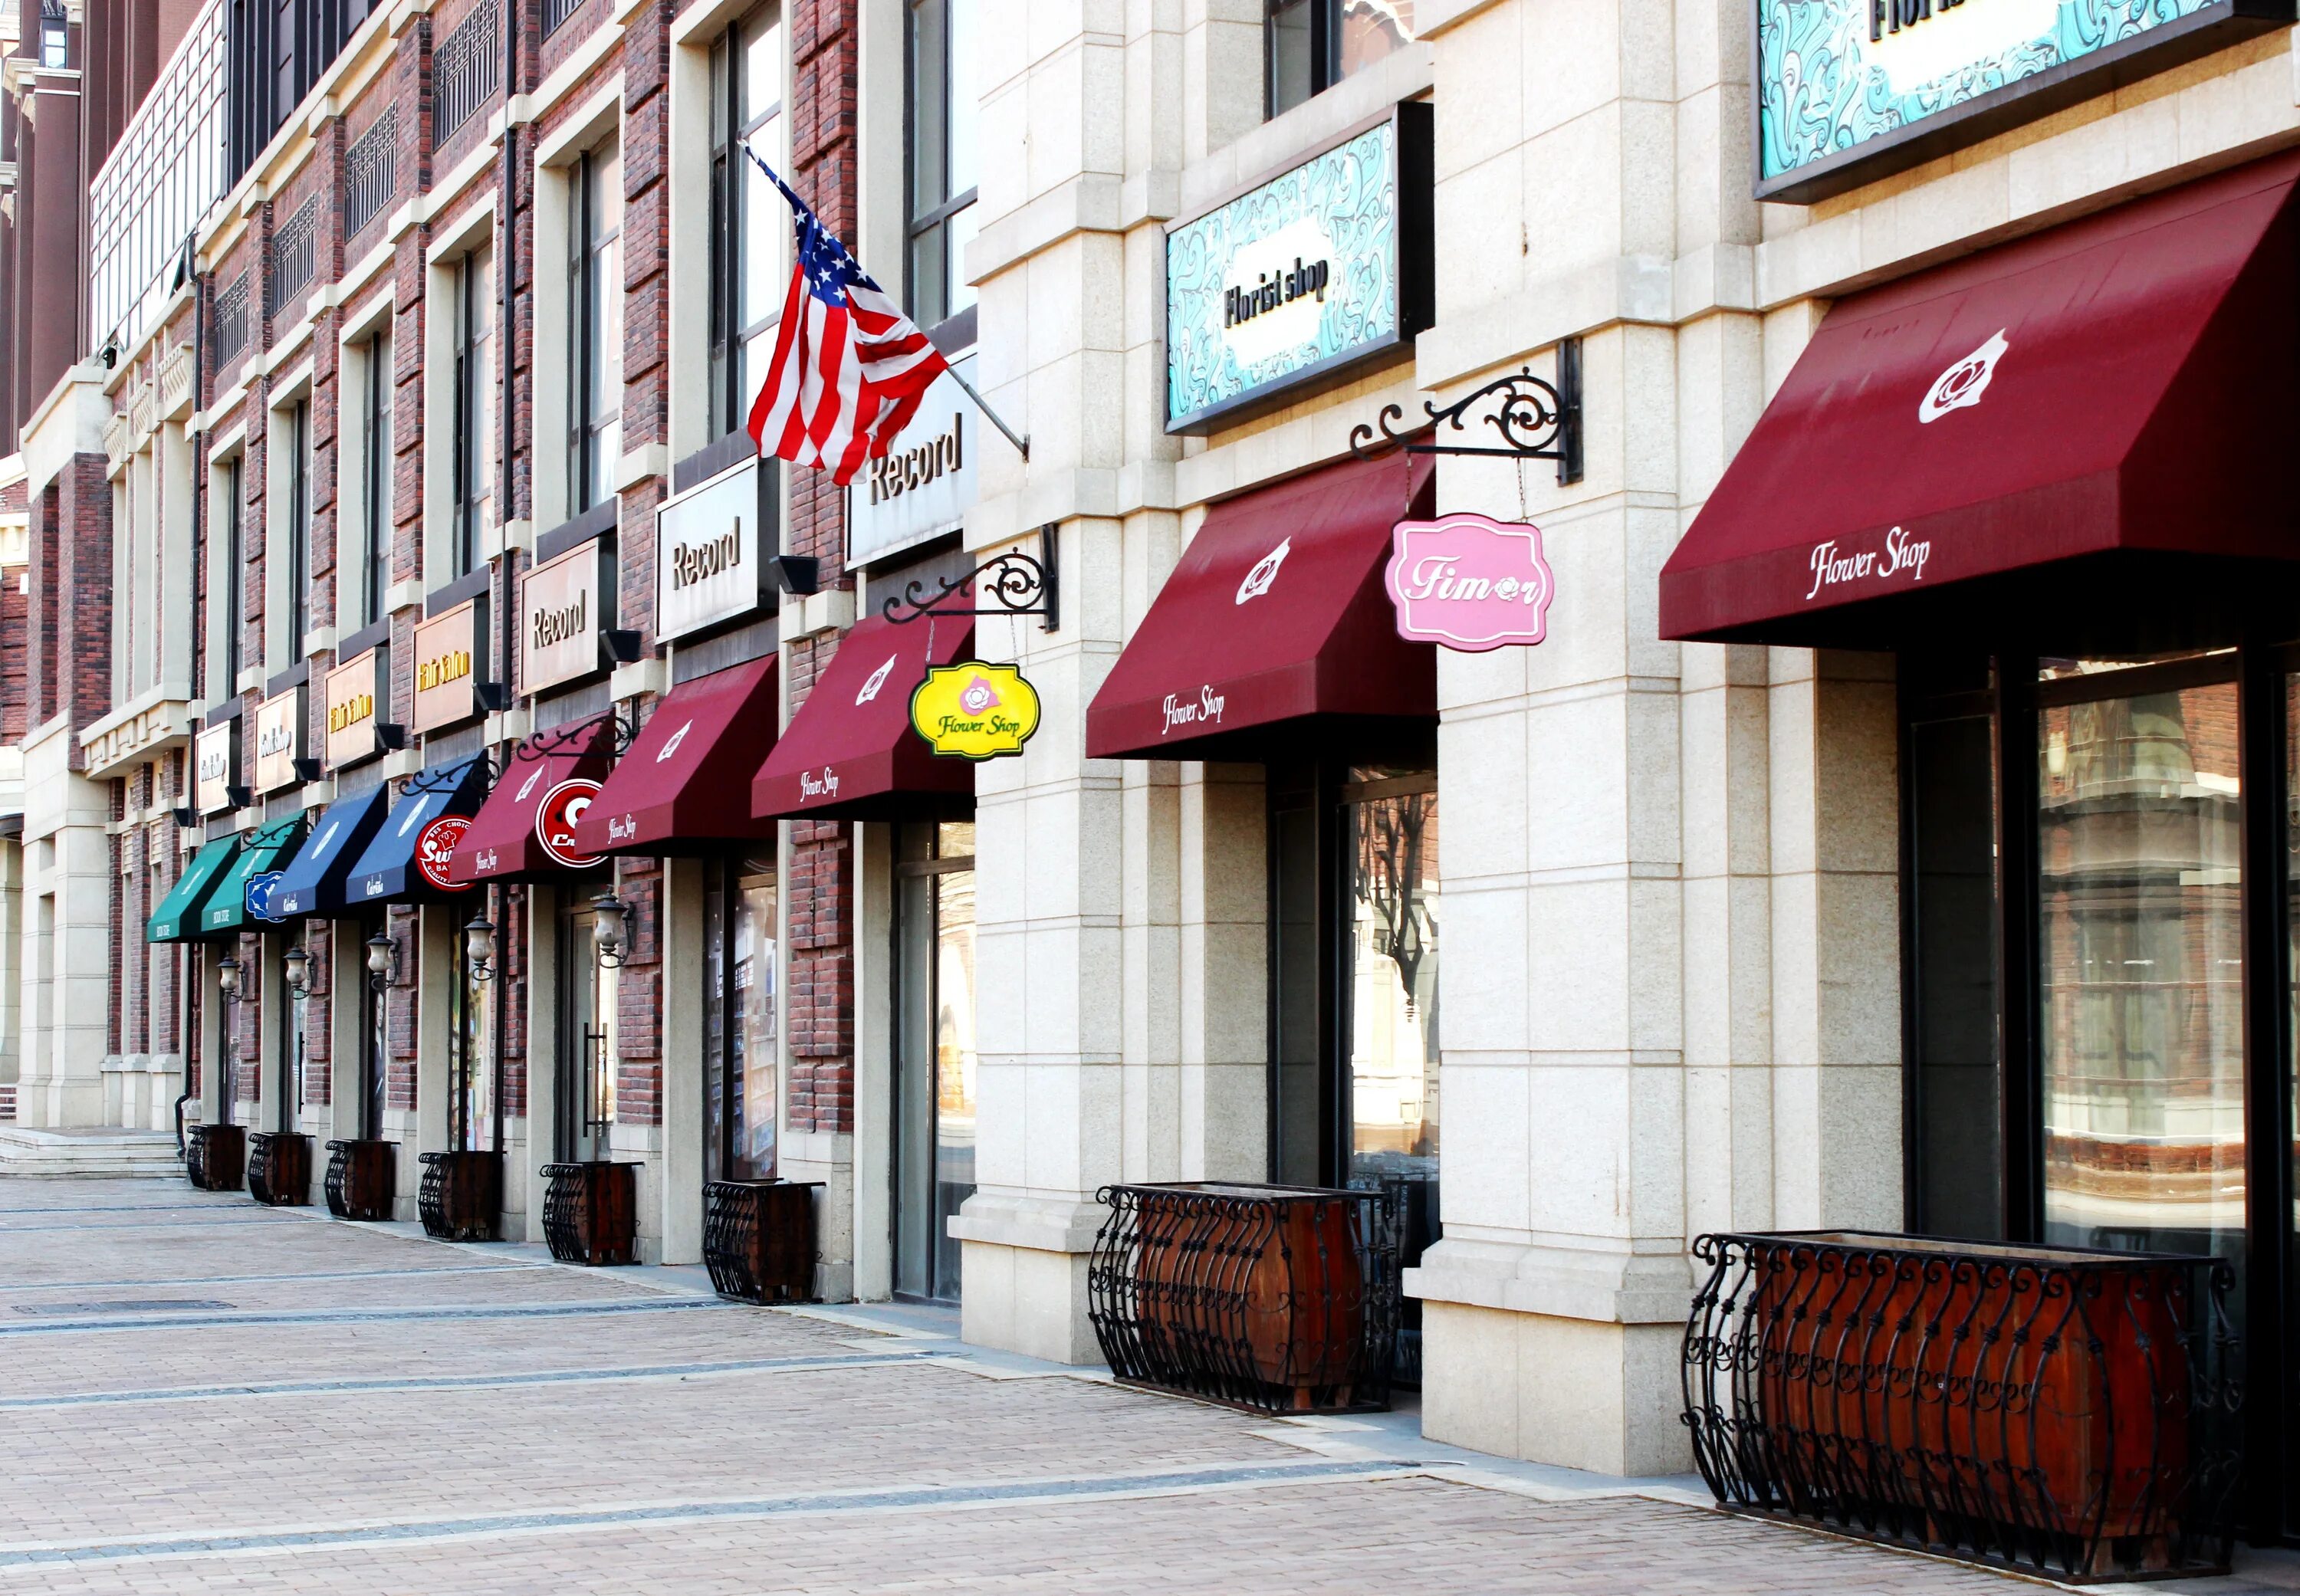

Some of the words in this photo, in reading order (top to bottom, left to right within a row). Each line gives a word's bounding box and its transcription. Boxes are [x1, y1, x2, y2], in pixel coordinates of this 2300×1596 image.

[1224, 270, 1283, 329] Florist
[1285, 257, 1329, 302] shop
[869, 412, 961, 506] Record
[673, 516, 741, 590] Record
[1806, 540, 1877, 600] Flower
[1878, 526, 1930, 580] Shop
[534, 589, 586, 650] Record
[418, 658, 439, 692] Hair
[439, 651, 470, 684] Salon
[330, 703, 347, 734] Hair
[347, 694, 373, 725] Salon
[937, 715, 984, 737] Flower
[986, 714, 1020, 737] Shop
[1162, 693, 1198, 735] Flower
[1198, 685, 1224, 723] Shop
[800, 771, 822, 803] Flower
[822, 766, 839, 797] Shop
[446, 821, 471, 830] CHOIC
[608, 818, 624, 844] Flower
[623, 813, 636, 839] Shop
[419, 840, 453, 863] Sw
